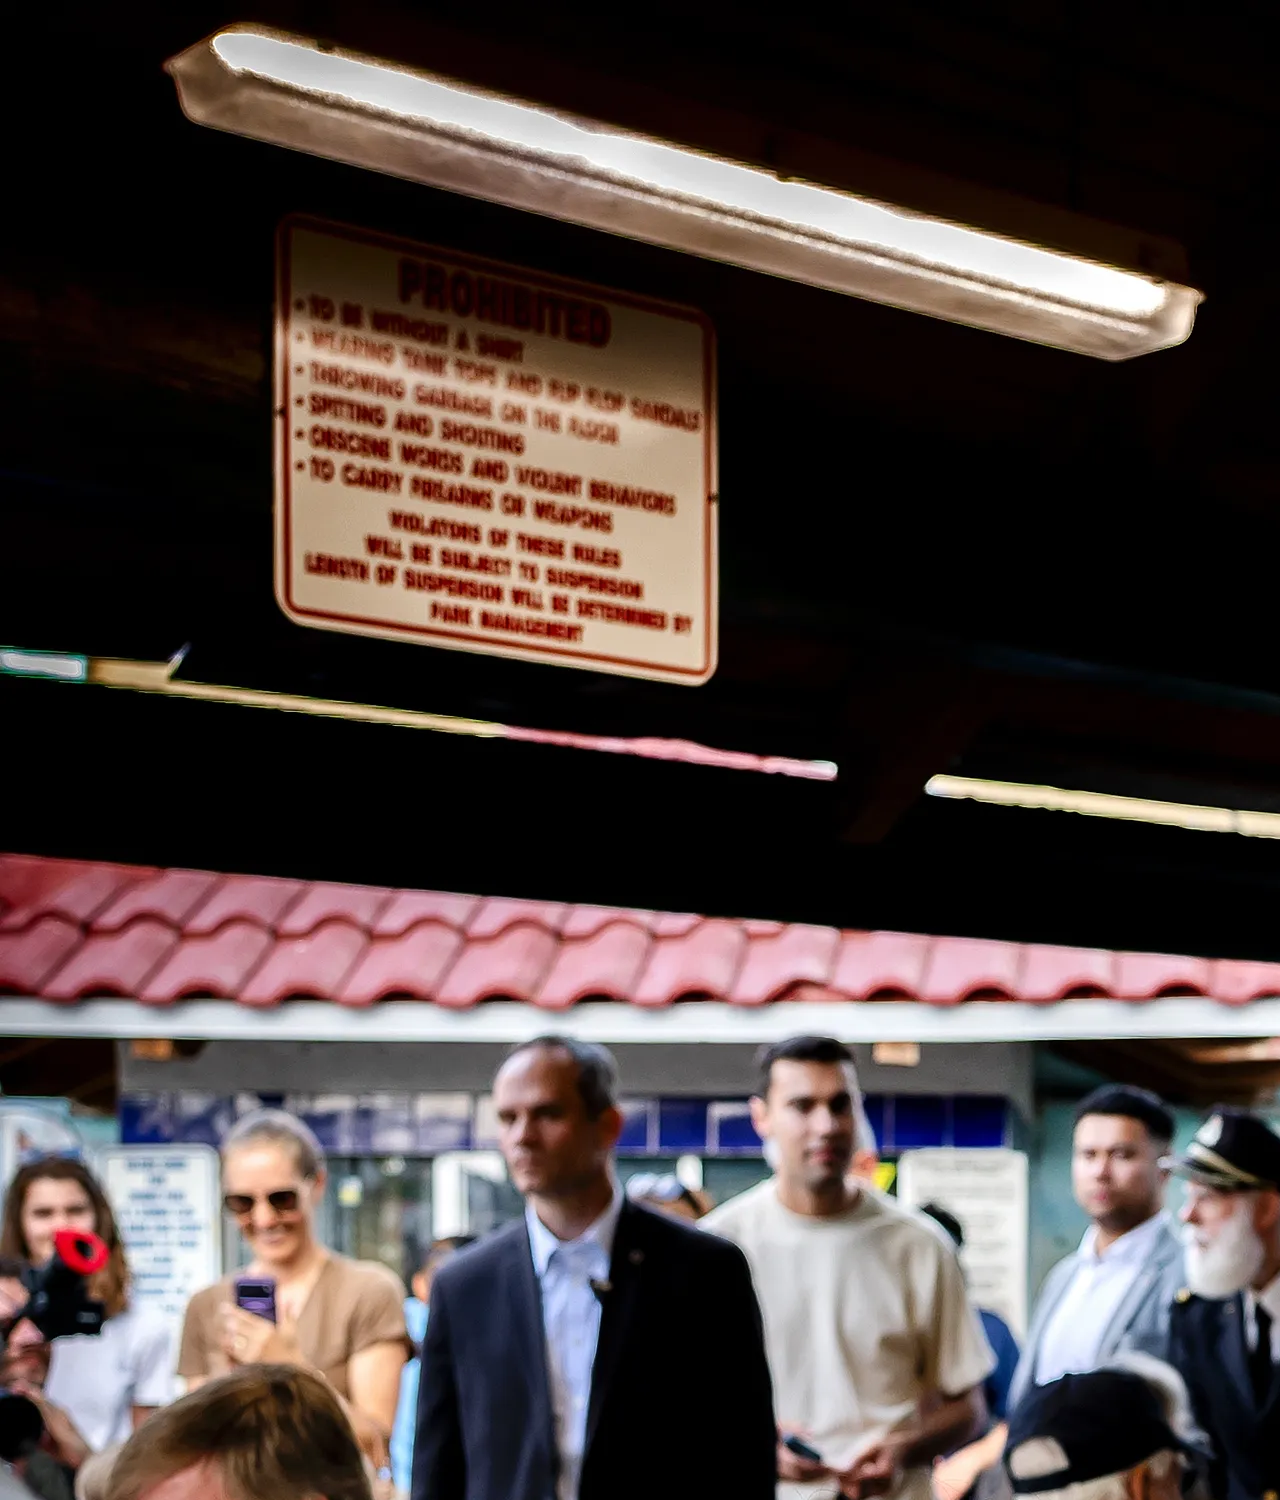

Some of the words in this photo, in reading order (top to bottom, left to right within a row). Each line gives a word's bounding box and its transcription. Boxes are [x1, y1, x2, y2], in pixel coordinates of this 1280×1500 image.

[309, 293, 335, 321] TO
[370, 310, 449, 344] WITHOUT
[456, 329, 469, 351] A
[398, 257, 612, 348] PROHIBITED
[310, 360, 406, 401] THROWING
[500, 402, 526, 424] ON
[533, 406, 562, 434] THE
[506, 370, 542, 396] AND
[309, 392, 387, 429] SPITTING
[394, 409, 434, 438] AND
[439, 418, 525, 456] SHOUTING
[310, 423, 392, 462] OBSCENE
[399, 443, 464, 475] WORDS
[469, 456, 509, 484] AND
[515, 465, 582, 496] VIOLENT
[588, 478, 678, 517] BEHAVIORS
[310, 454, 335, 483] TO
[341, 462, 403, 495] CARRY
[410, 474, 494, 511] FIREARMS
[500, 492, 526, 516] OR
[533, 499, 614, 534] WEAPONS
[365, 533, 403, 560] WILL
[410, 542, 432, 564] BE
[440, 545, 512, 577] SUBJECT
[518, 560, 539, 583] TO
[546, 566, 644, 601] SUSPENSION
[388, 508, 482, 544] VIOLATORS
[487, 528, 508, 549] OF
[516, 532, 565, 559] THESE
[571, 543, 622, 569] RULES
[403, 566, 504, 603] SUSPENSION
[511, 586, 543, 611] WILL
[479, 609, 585, 642] MANAGEMENT
